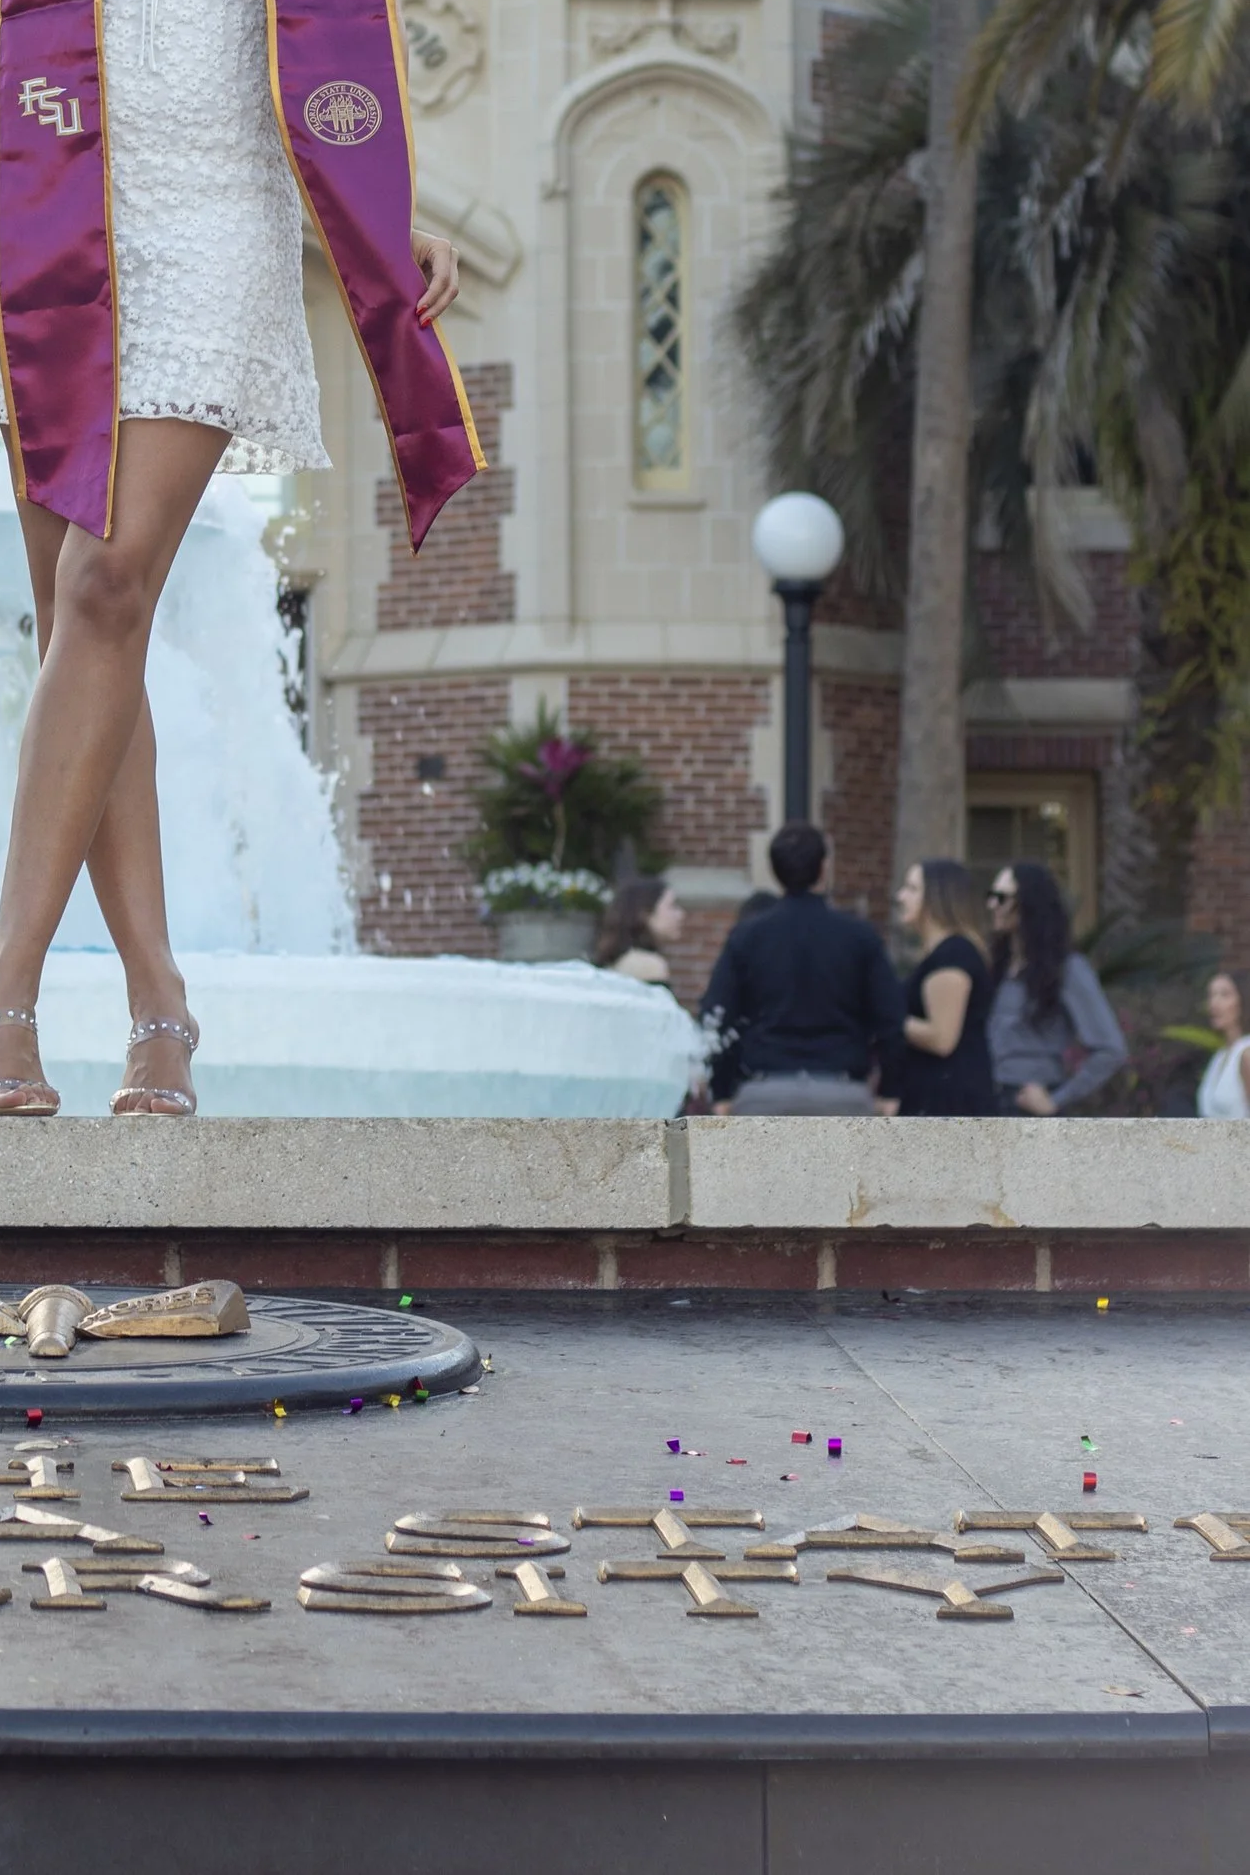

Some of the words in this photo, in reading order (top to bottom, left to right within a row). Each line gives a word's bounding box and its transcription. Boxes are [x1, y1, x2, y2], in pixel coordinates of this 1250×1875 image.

[17, 76, 85, 136] FSU
[308, 97, 323, 132] FLORIDA
[319, 85, 347, 99] STATE
[349, 85, 378, 131] UNIVERSITY
[336, 134, 356, 143] 1851
